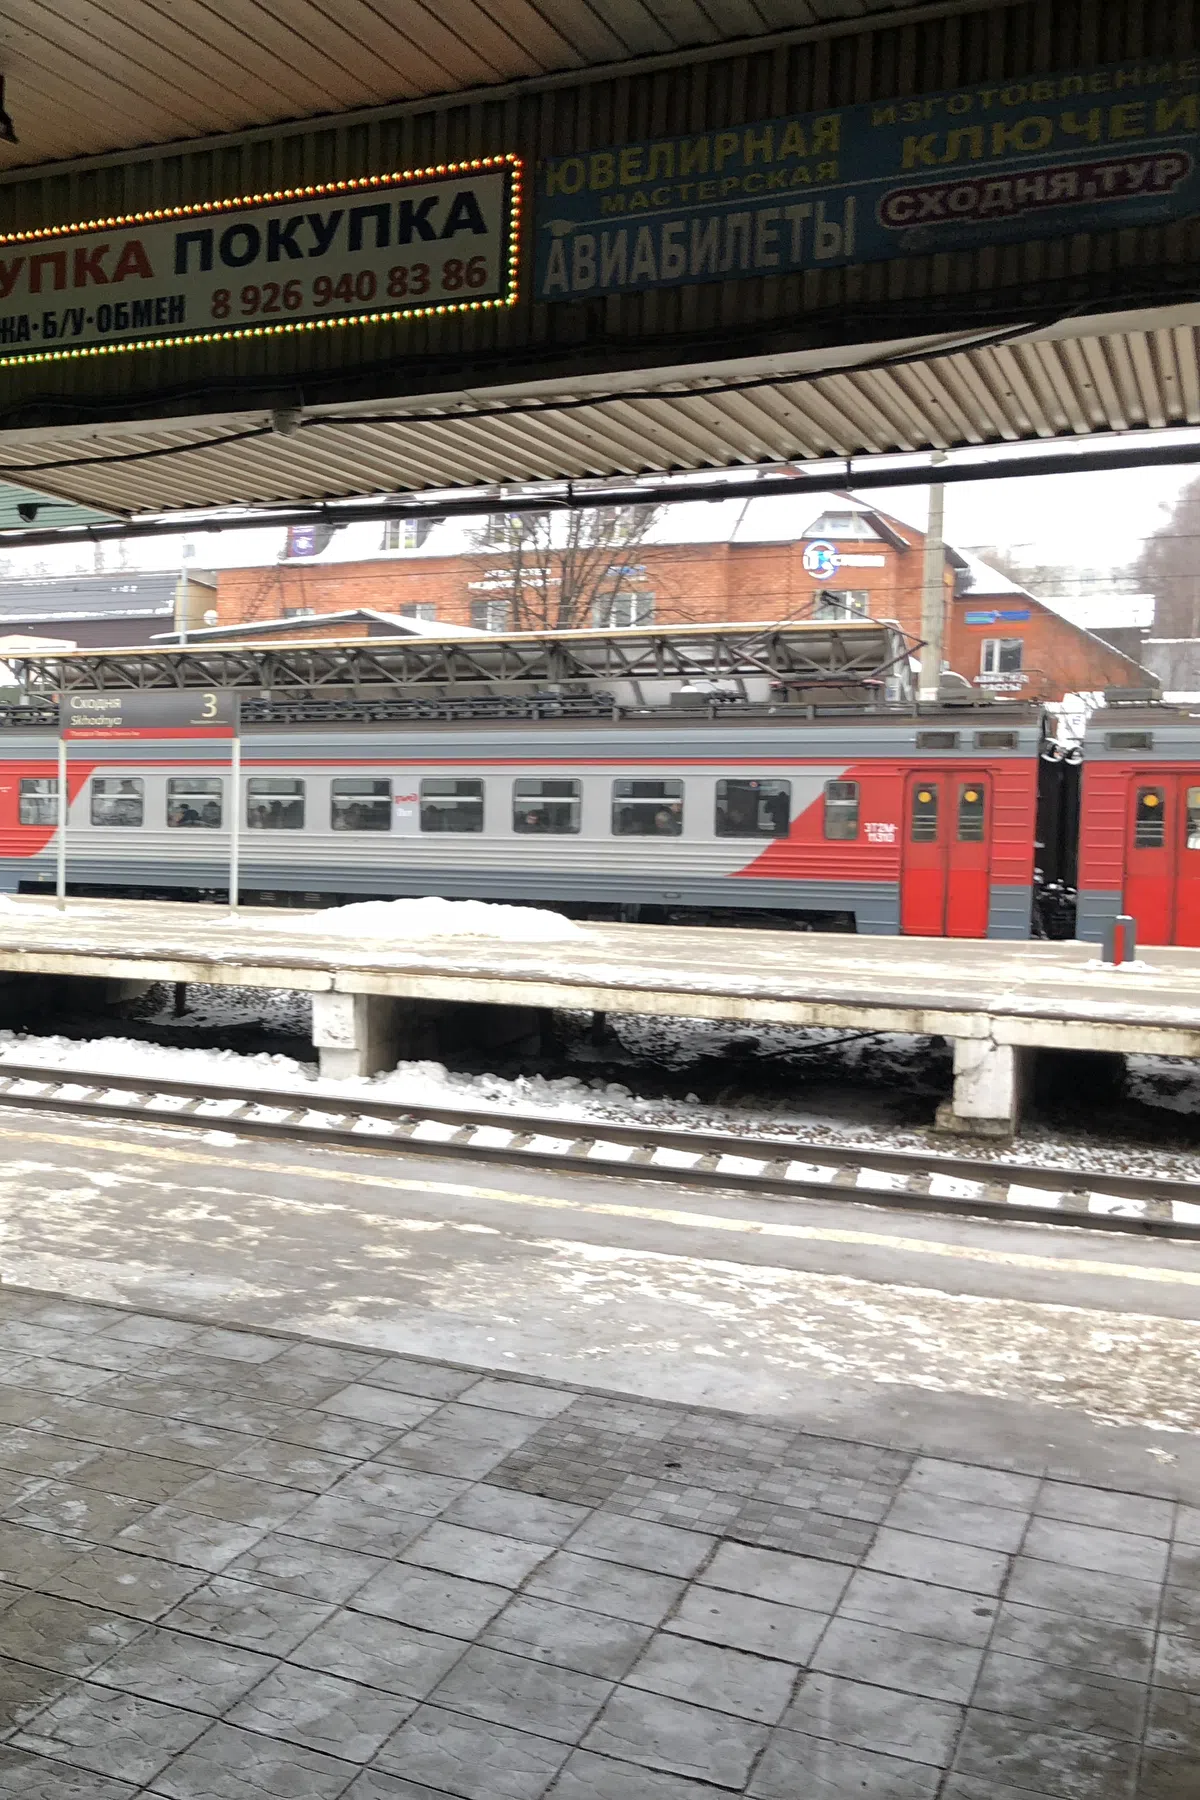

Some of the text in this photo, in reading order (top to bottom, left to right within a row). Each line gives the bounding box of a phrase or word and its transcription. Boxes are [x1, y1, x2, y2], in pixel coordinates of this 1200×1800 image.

[871, 58, 1199, 127] ИЗГОТОВЛЕНИЕ
[545, 114, 843, 197] ЮВЕЛИРНАЯ
[902, 88, 1200, 168] КЛЮЧЕЙ
[600, 160, 839, 214] МАСТЕРСКАЯ
[174, 190, 489, 275] ПОКУПКА
[542, 195, 857, 295] АВИАБИЛЕТЫ
[211, 256, 489, 319] 8 926 940 83 86
[70, 693, 218, 718] Сходня 3
[70, 715, 122, 727] Skhodnya
